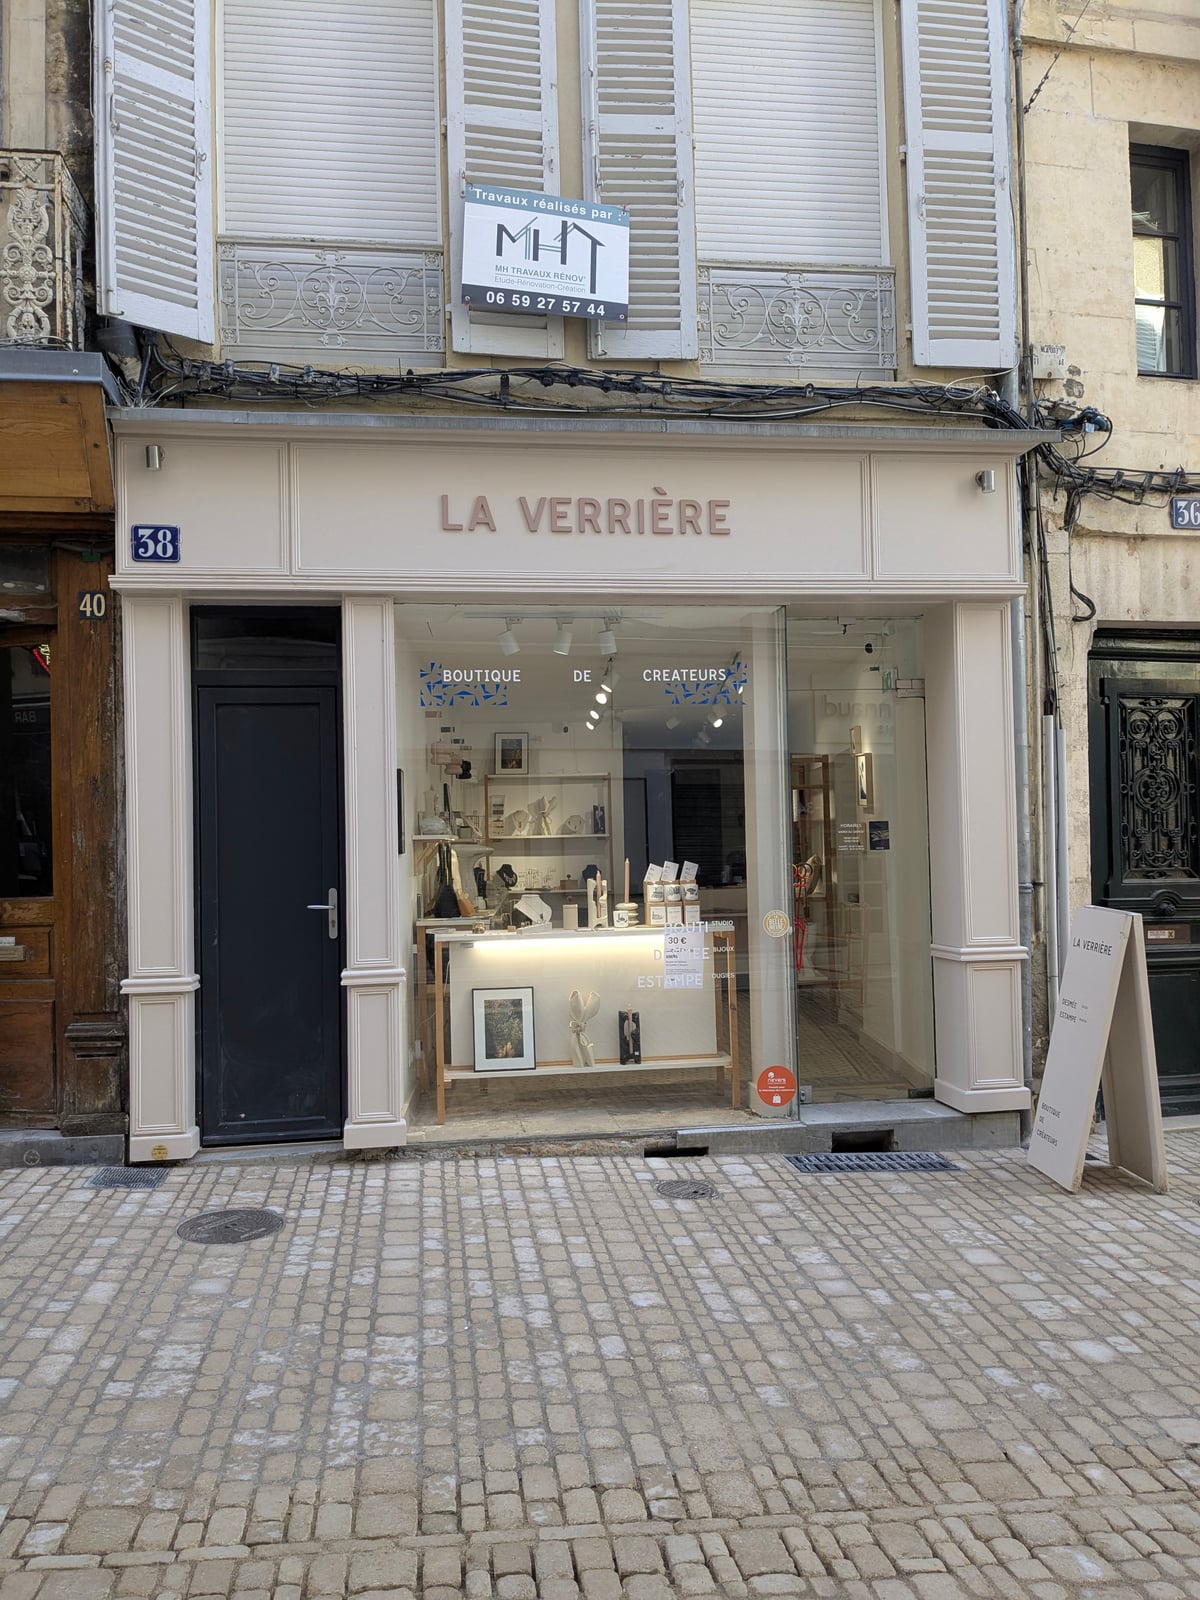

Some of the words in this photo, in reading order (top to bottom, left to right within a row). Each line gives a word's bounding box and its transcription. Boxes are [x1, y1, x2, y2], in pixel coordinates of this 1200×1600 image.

[474, 188, 528, 207] Travaux
[533, 199, 586, 216] réalisés
[591, 208, 613, 220] par
[495, 264, 508, 273] MH
[511, 266, 552, 279] TRAVAUX
[486, 291, 505, 304] 06
[512, 294, 531, 307] 59
[537, 297, 556, 310] 27
[562, 300, 581, 313] 57
[587, 303, 606, 316] 44
[440, 494, 497, 532] LA
[518, 486, 731, 536] VERRIÈRE
[1176, 501, 1200, 525] 36
[138, 528, 173, 558] 38
[79, 593, 106, 617] 40
[442, 669, 521, 682] BOUTIQUE
[573, 670, 592, 682] DE
[642, 668, 727, 681] CREATEURS
[668, 936, 679, 944] 30
[680, 936, 687, 944] €
[1072, 937, 1081, 948] LA
[1083, 940, 1113, 956] VERRIÈRE
[637, 974, 704, 988] ESTAMPE
